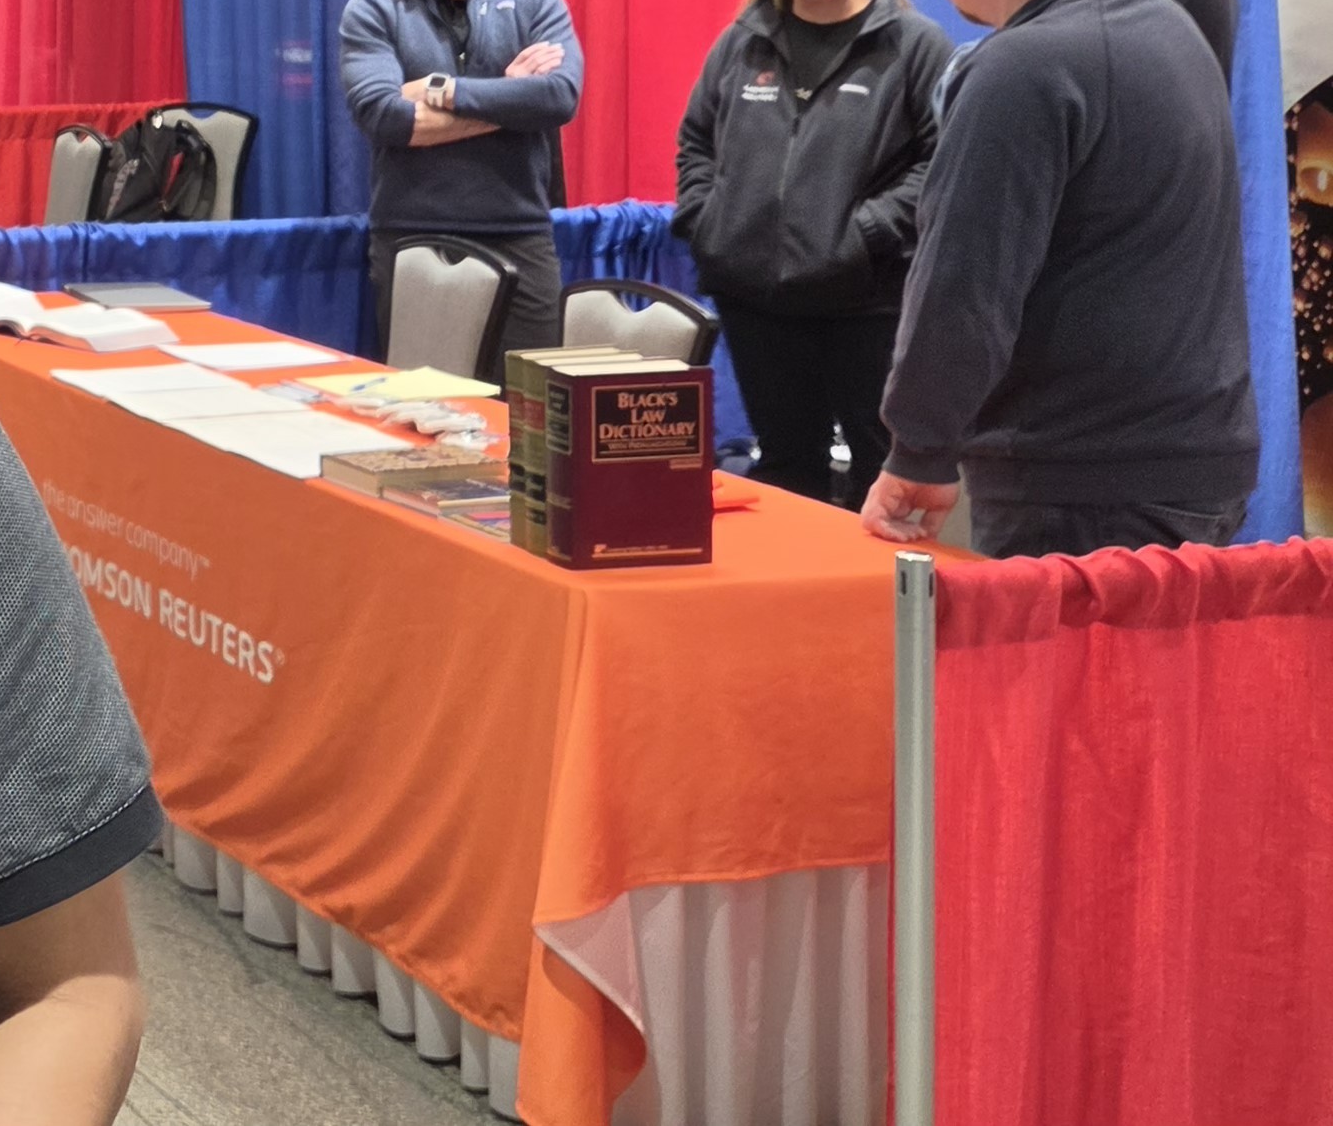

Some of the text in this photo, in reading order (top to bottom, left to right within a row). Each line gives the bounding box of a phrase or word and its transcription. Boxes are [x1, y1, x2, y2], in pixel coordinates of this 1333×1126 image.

[617, 392, 679, 409] BLACK'S
[631, 408, 666, 424] LAW
[598, 421, 696, 440] DICTIONARY
[42, 478, 65, 512] the
[67, 494, 124, 539] answer
[66, 544, 153, 620] OMSON
